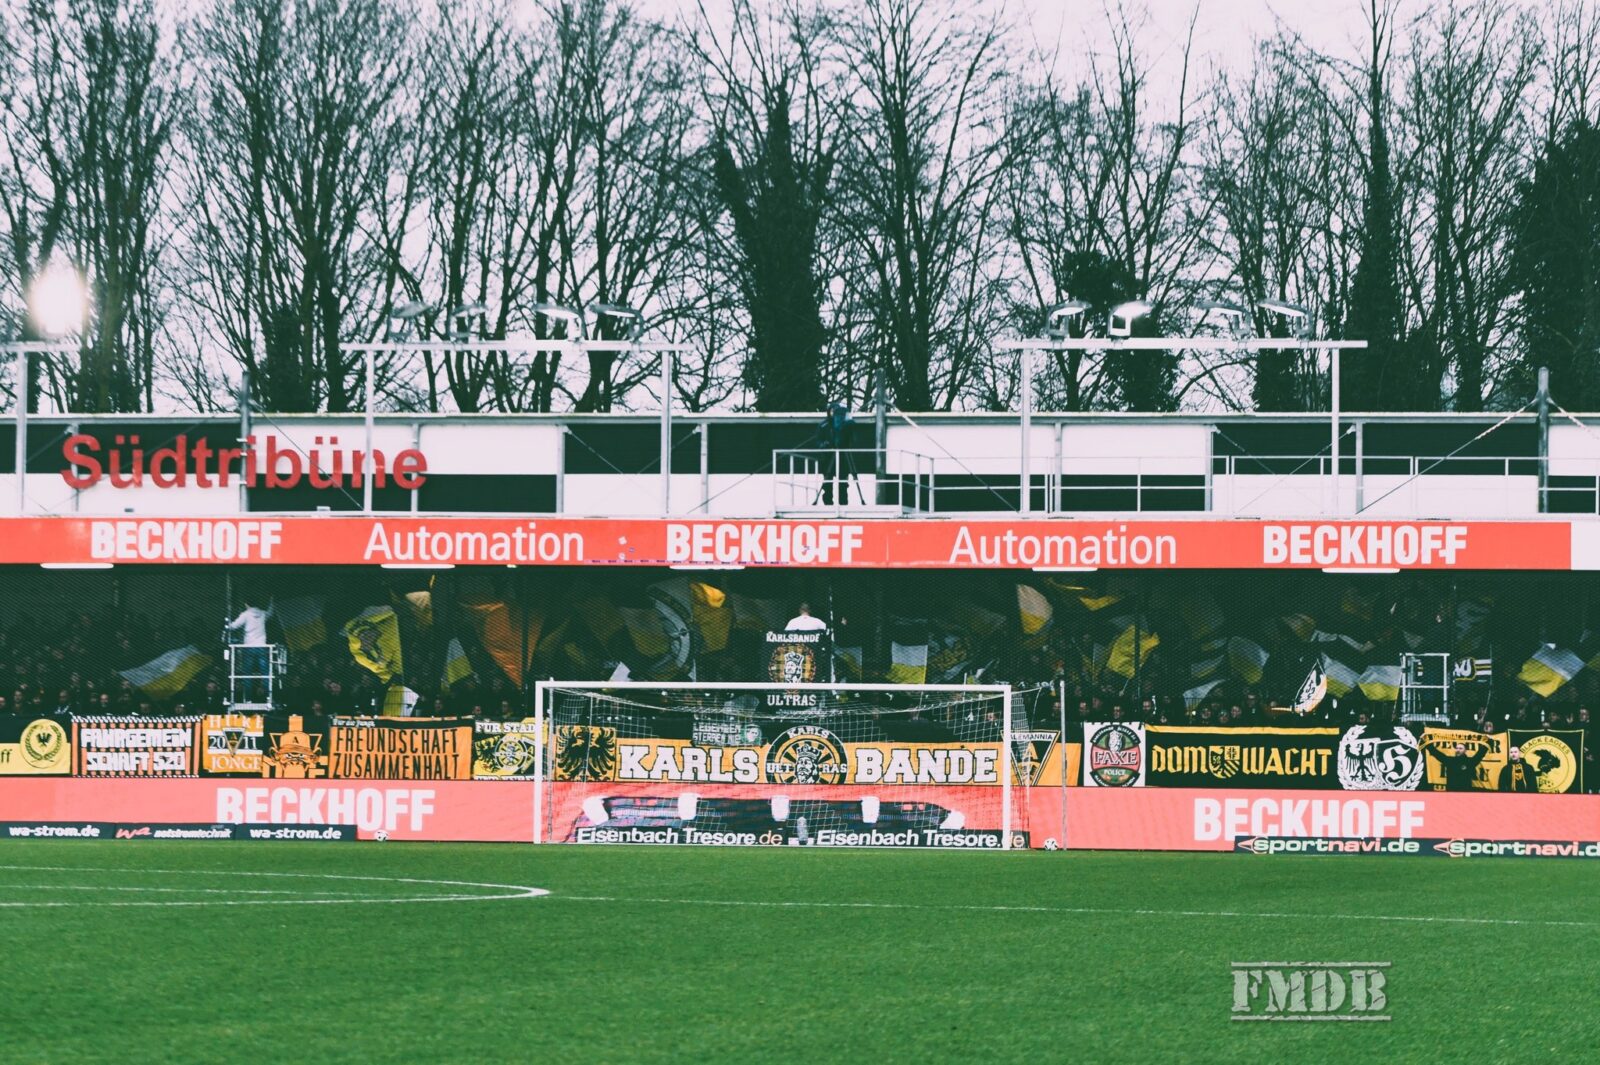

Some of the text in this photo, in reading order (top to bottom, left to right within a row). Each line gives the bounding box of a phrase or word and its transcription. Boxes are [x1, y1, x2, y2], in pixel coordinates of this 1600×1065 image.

[60, 434, 428, 490] Südtribüne
[91, 521, 1468, 565] BECKHOFF Automation BECKHOFF Automation BECKHOFF
[766, 631, 820, 643] KARLSBANDE
[767, 694, 817, 706] ULTRAS
[503, 721, 541, 733] STAD
[787, 726, 830, 739] KARLS
[209, 736, 257, 750] 20 11
[336, 727, 458, 754] FREUNDSCHAFT
[211, 755, 261, 770] JONGE
[333, 751, 460, 780] ZUSAMMENHALT
[619, 745, 998, 784] KARLS BANDE
[1094, 750, 1138, 766] FAXE
[1152, 744, 1333, 777] DOM WACHT
[216, 786, 436, 832] BECKHOFF
[1193, 798, 1425, 841] BECKHOFF
[9, 825, 101, 838] wa-strom.de
[249, 827, 342, 840] wa-strom.de
[577, 827, 783, 845] Eisenbach Tresore.de
[816, 829, 1025, 848] Eisenbach Tresore.e
[1252, 838, 1420, 854] sportnavi.de
